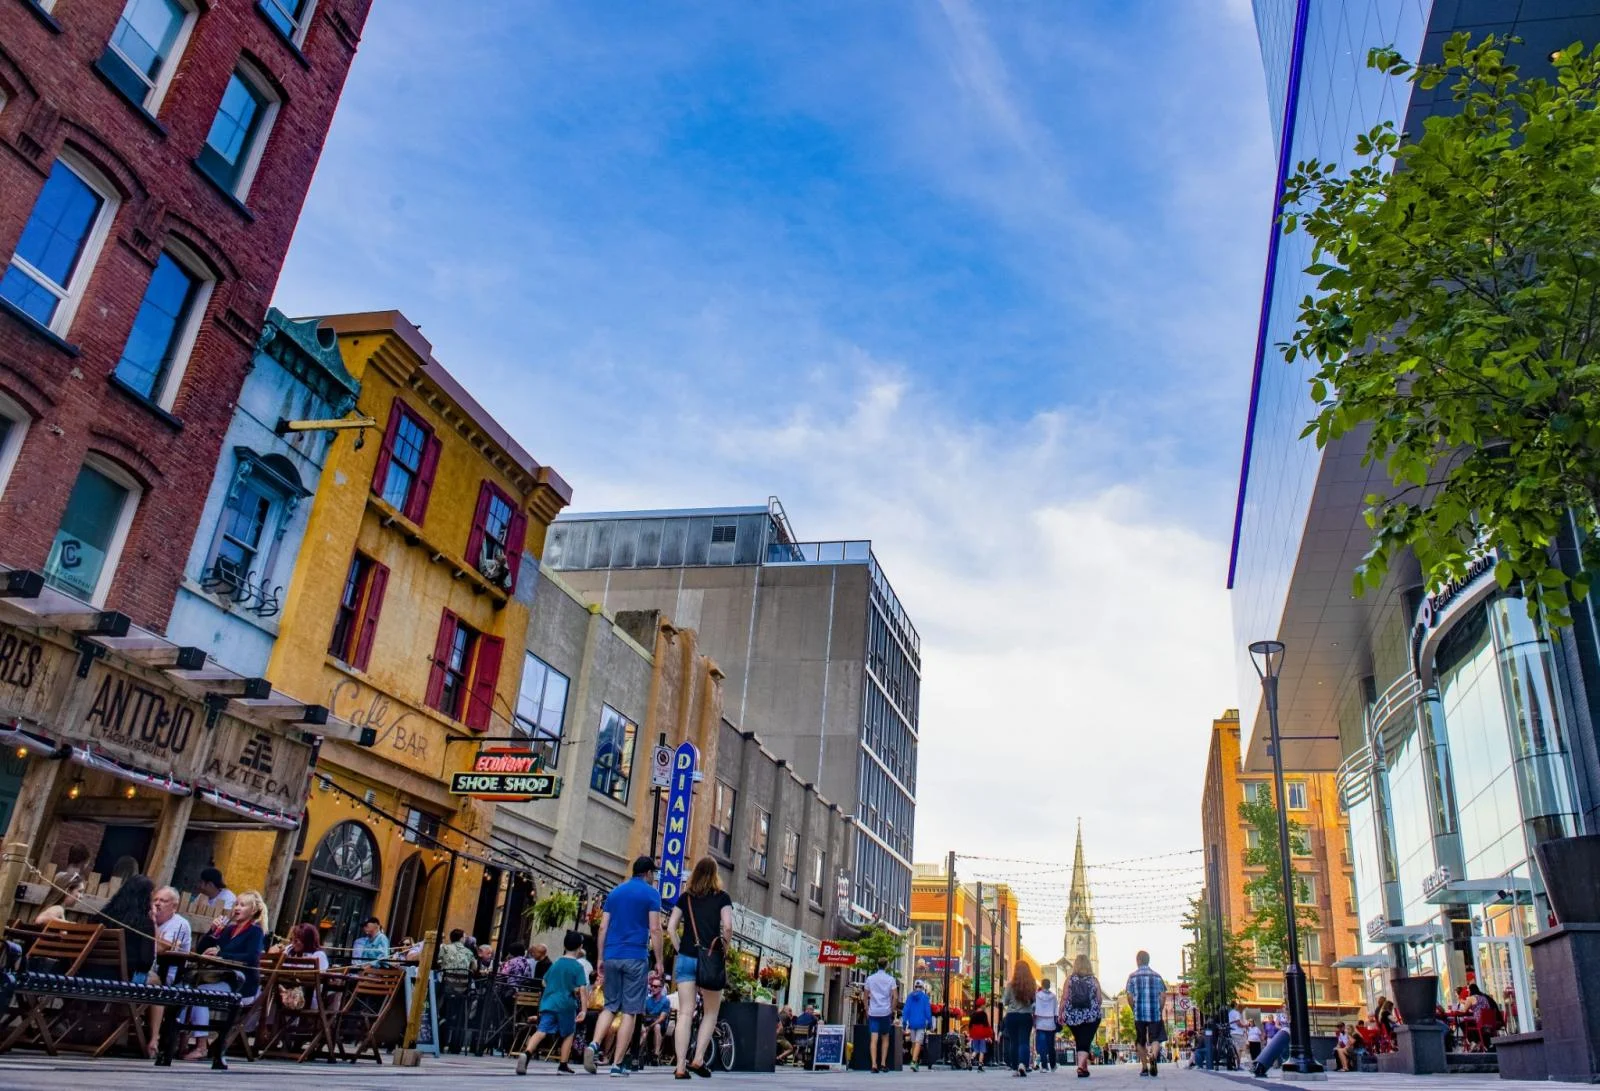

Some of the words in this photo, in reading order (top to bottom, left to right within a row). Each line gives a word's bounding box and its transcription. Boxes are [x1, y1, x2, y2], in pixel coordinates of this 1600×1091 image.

[86, 674, 194, 754] ANTOJO
[134, 740, 166, 759] TEQUILA
[393, 726, 428, 761] BAR
[206, 757, 291, 798] AZTECA
[475, 754, 537, 772] ECONOMY
[457, 776, 500, 791] SHOE
[504, 777, 549, 792] SHOP
[662, 753, 691, 899] DIAMOND
